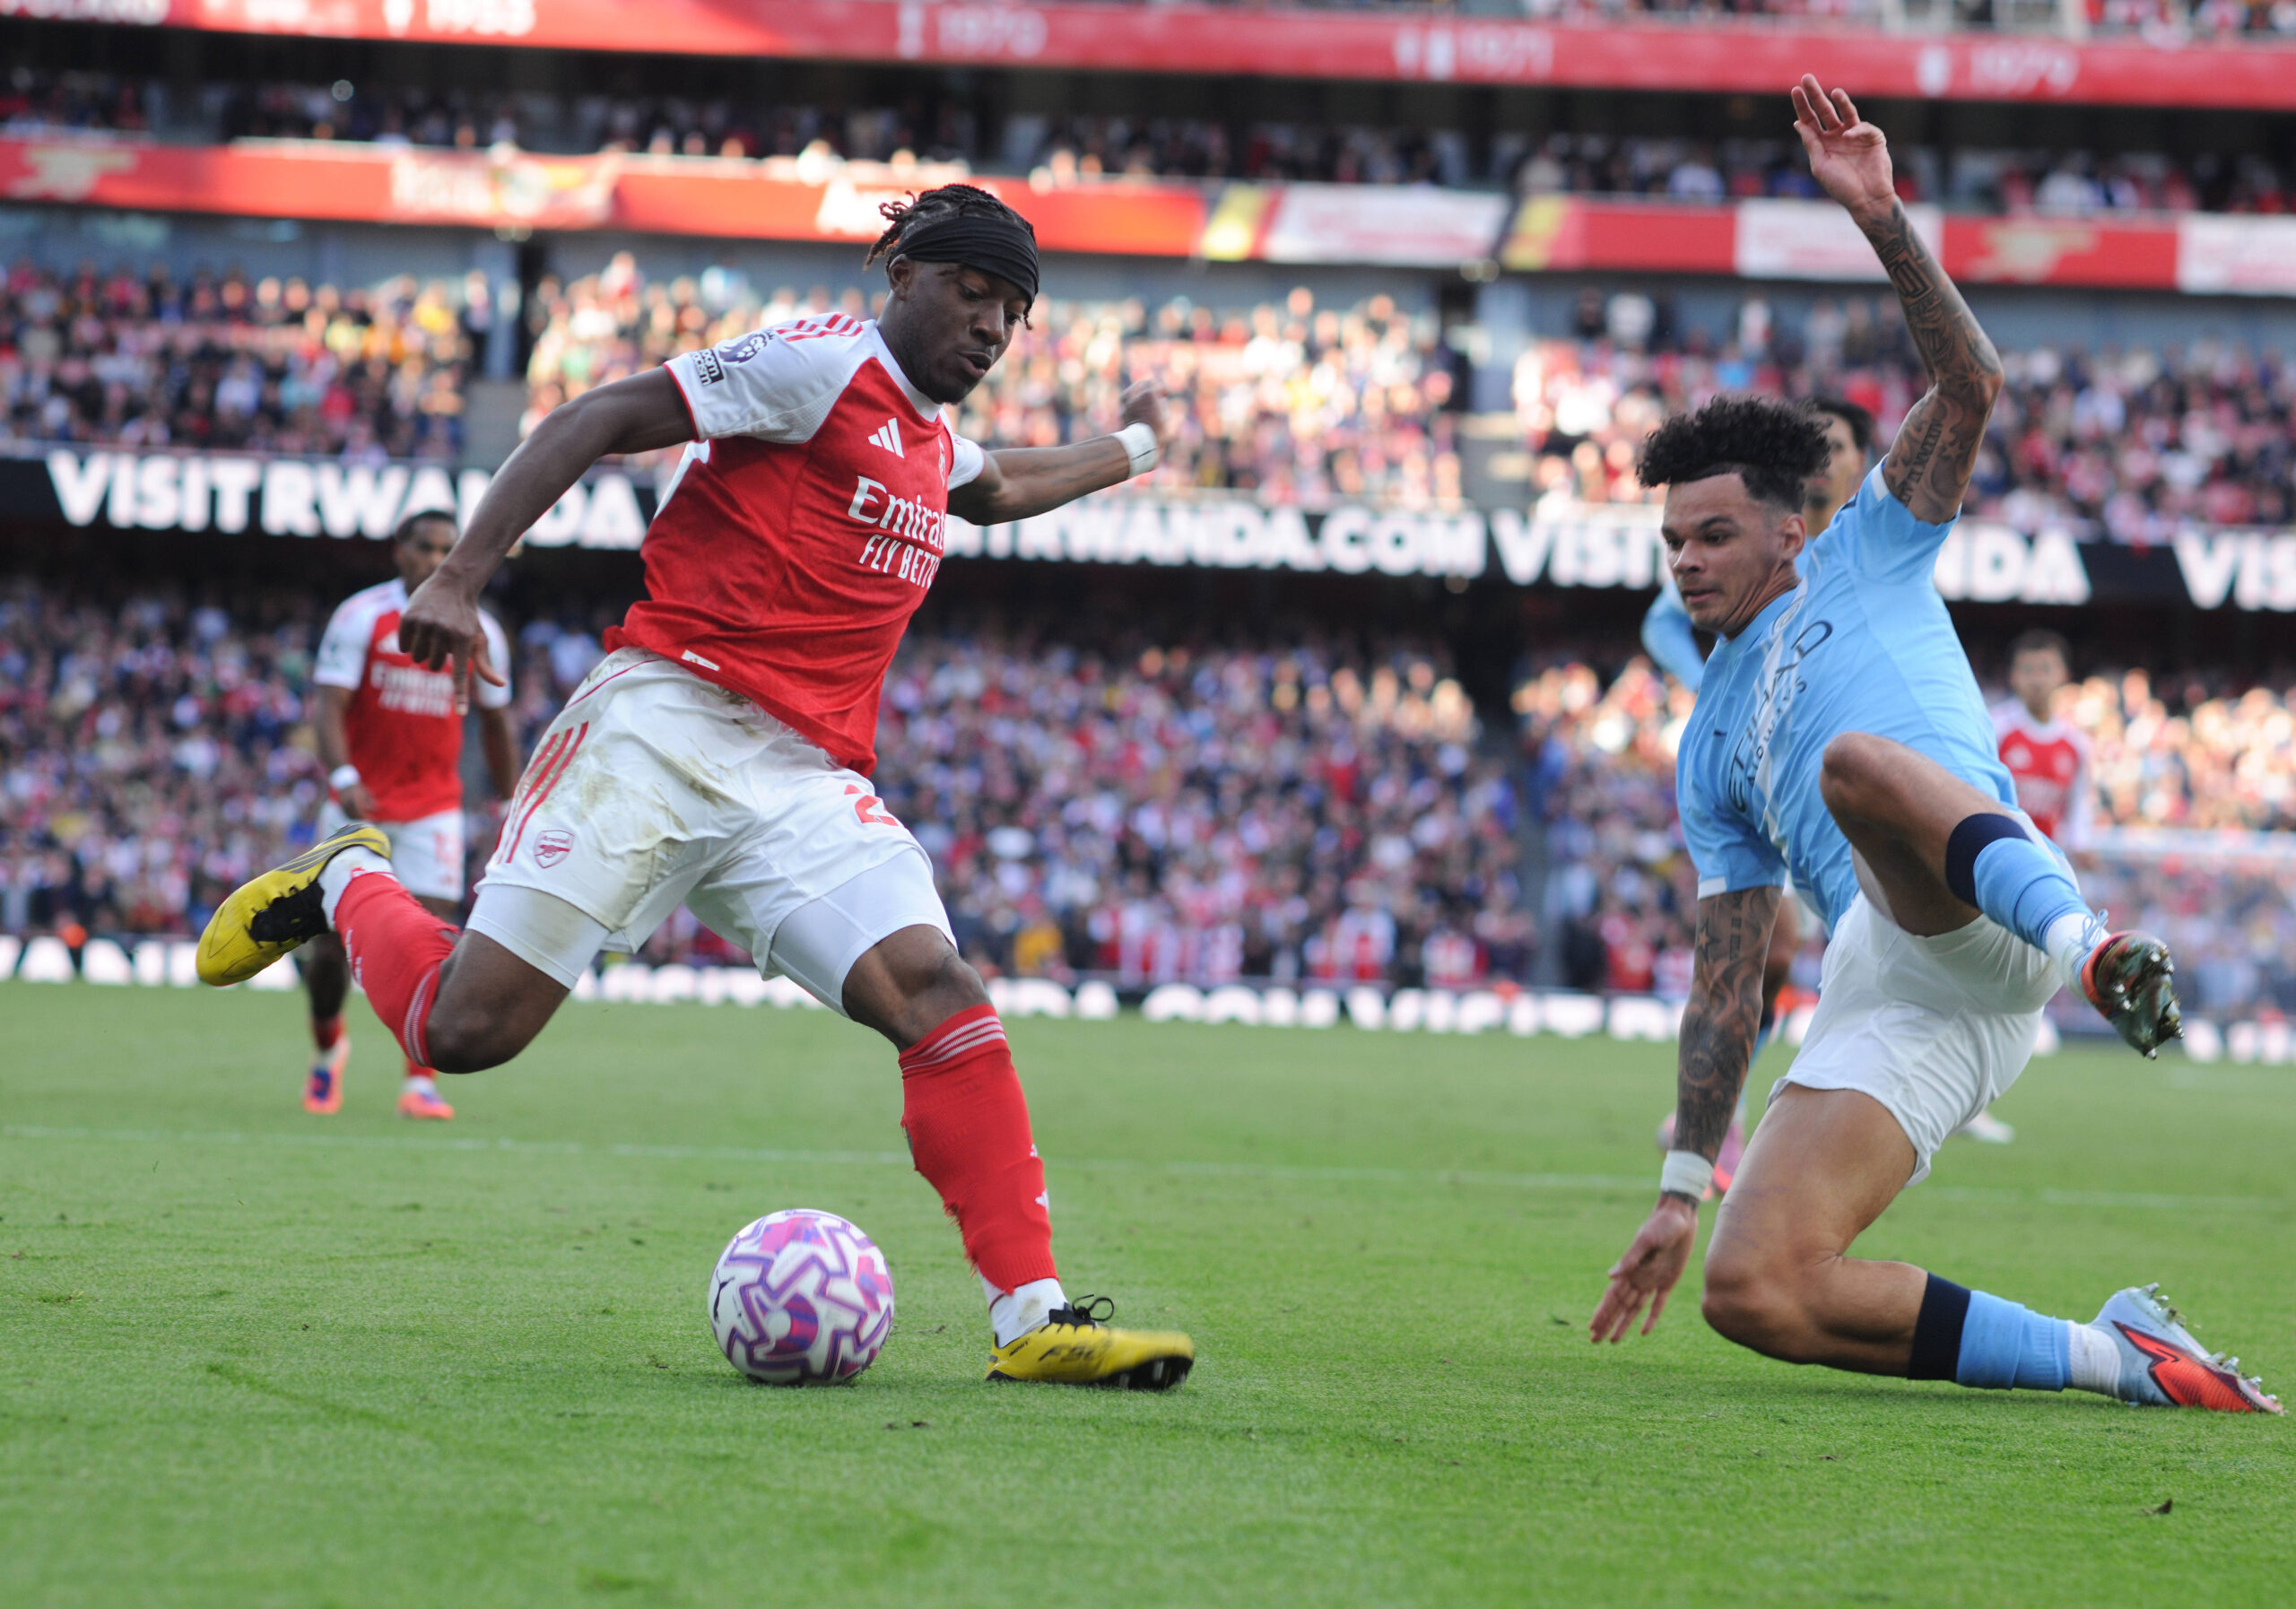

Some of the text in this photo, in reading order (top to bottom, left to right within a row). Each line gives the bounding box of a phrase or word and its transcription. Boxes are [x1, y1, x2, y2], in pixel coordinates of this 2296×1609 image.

[858, 534, 942, 589] FLY BETTE
[843, 783, 900, 827] 2
